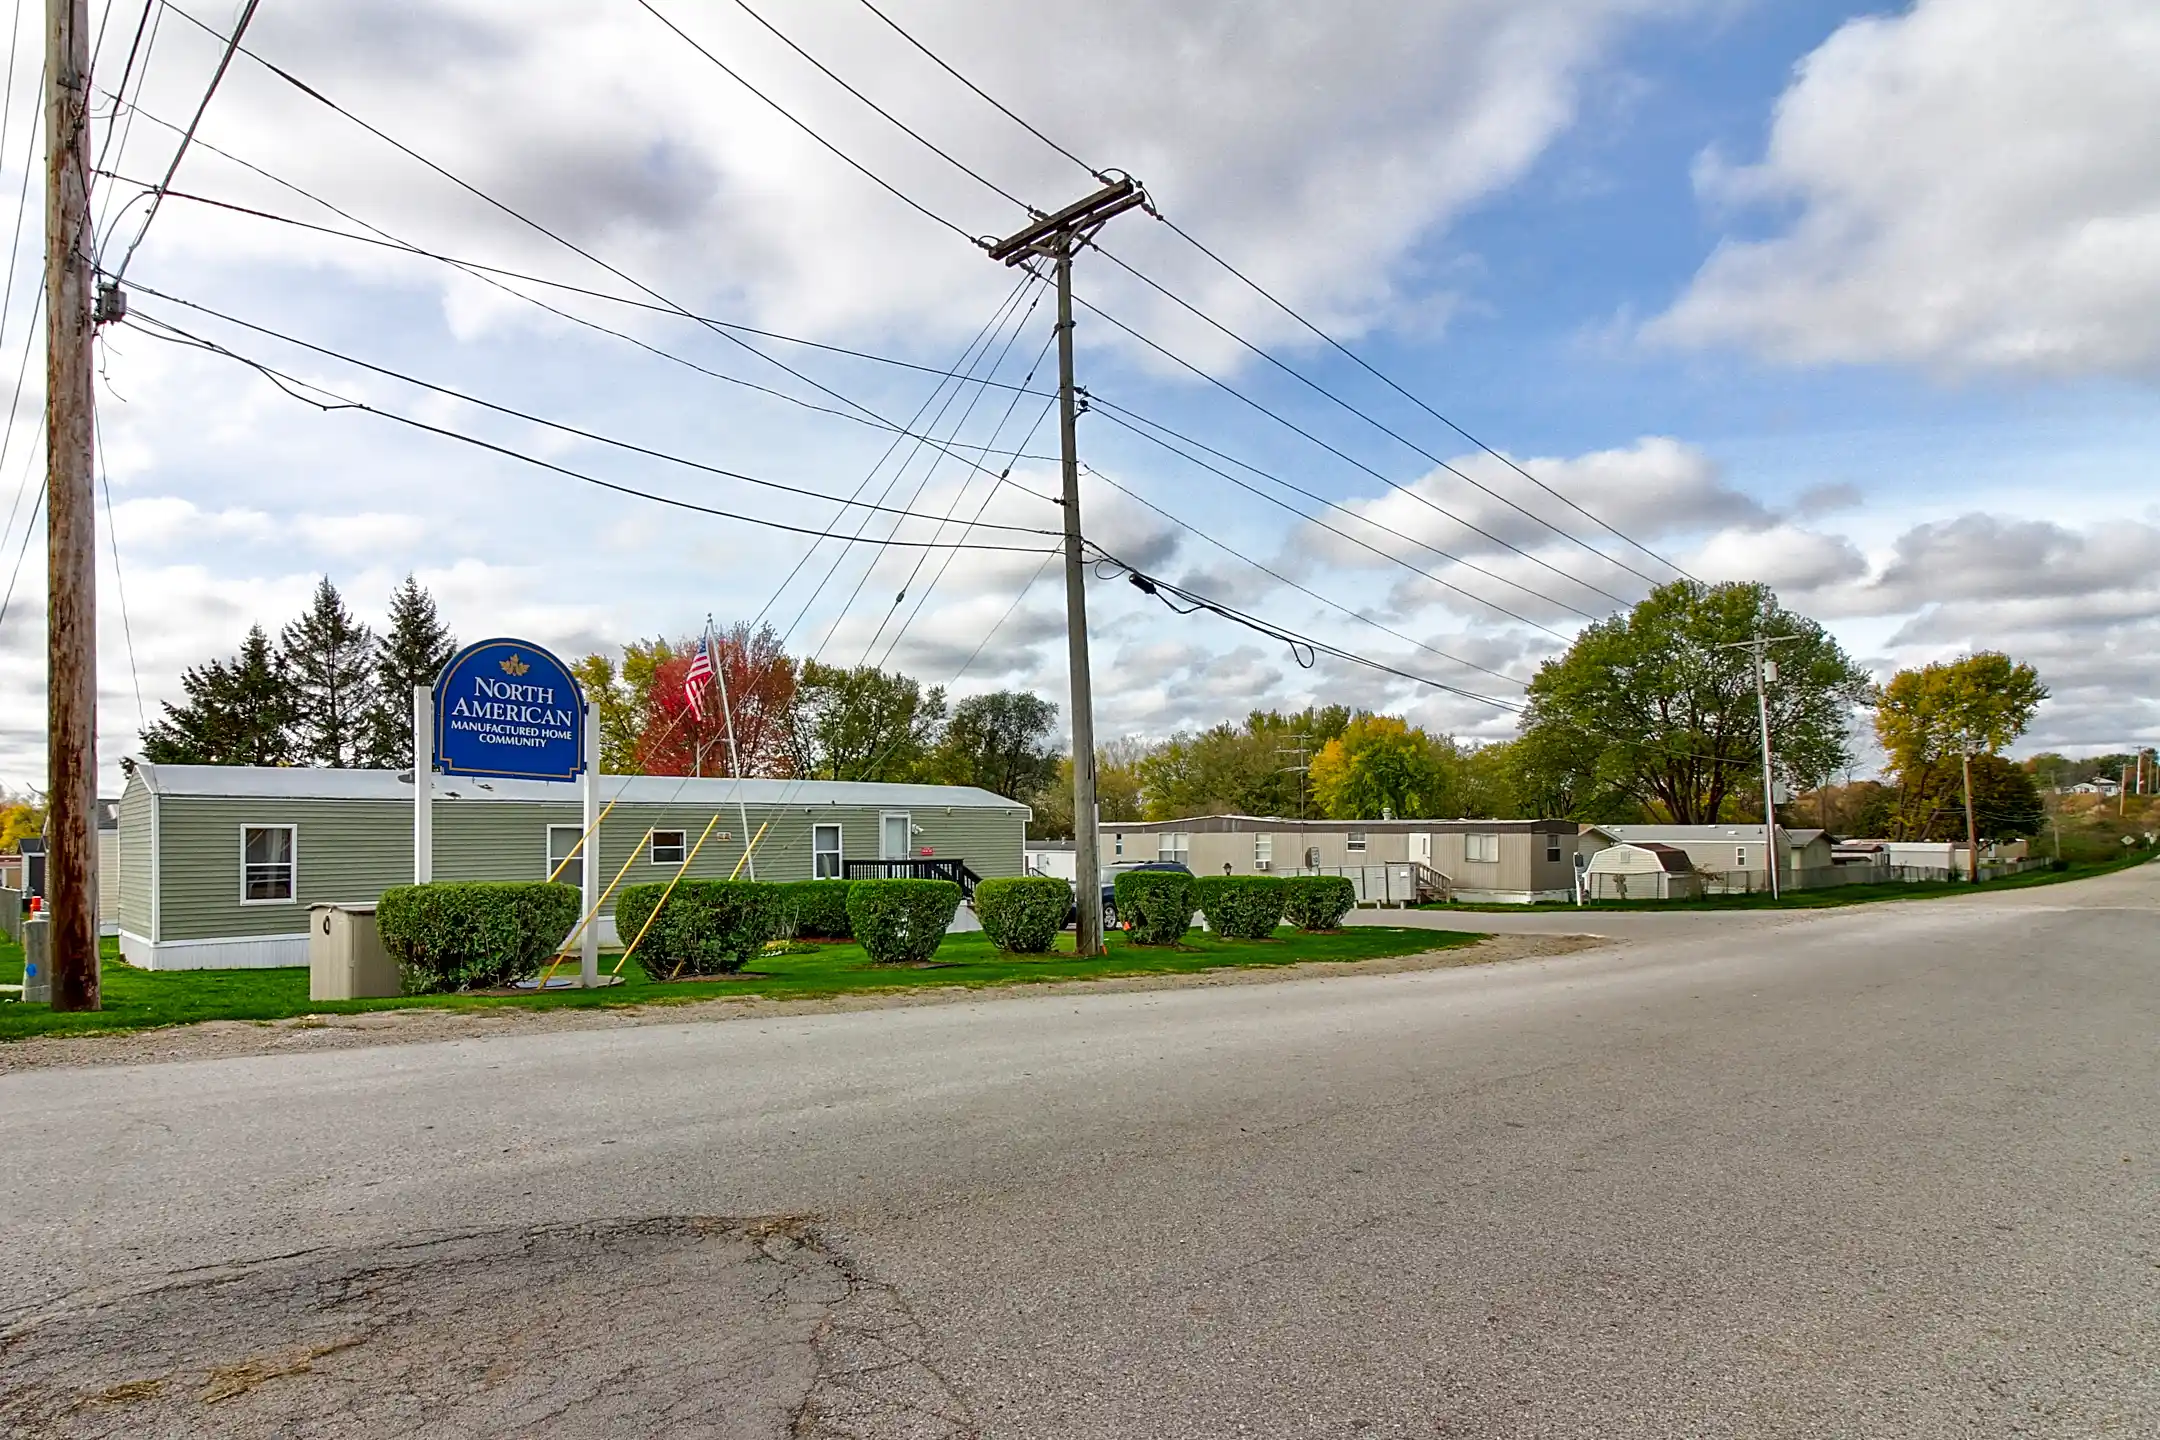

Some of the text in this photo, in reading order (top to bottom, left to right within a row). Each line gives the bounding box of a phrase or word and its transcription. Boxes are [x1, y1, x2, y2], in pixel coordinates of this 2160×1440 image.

[474, 676, 554, 704] NORTH
[452, 697, 572, 727] AMERICAN
[451, 720, 572, 740] MANUFACTURED HOME
[479, 733, 547, 748] COMMUNITY
